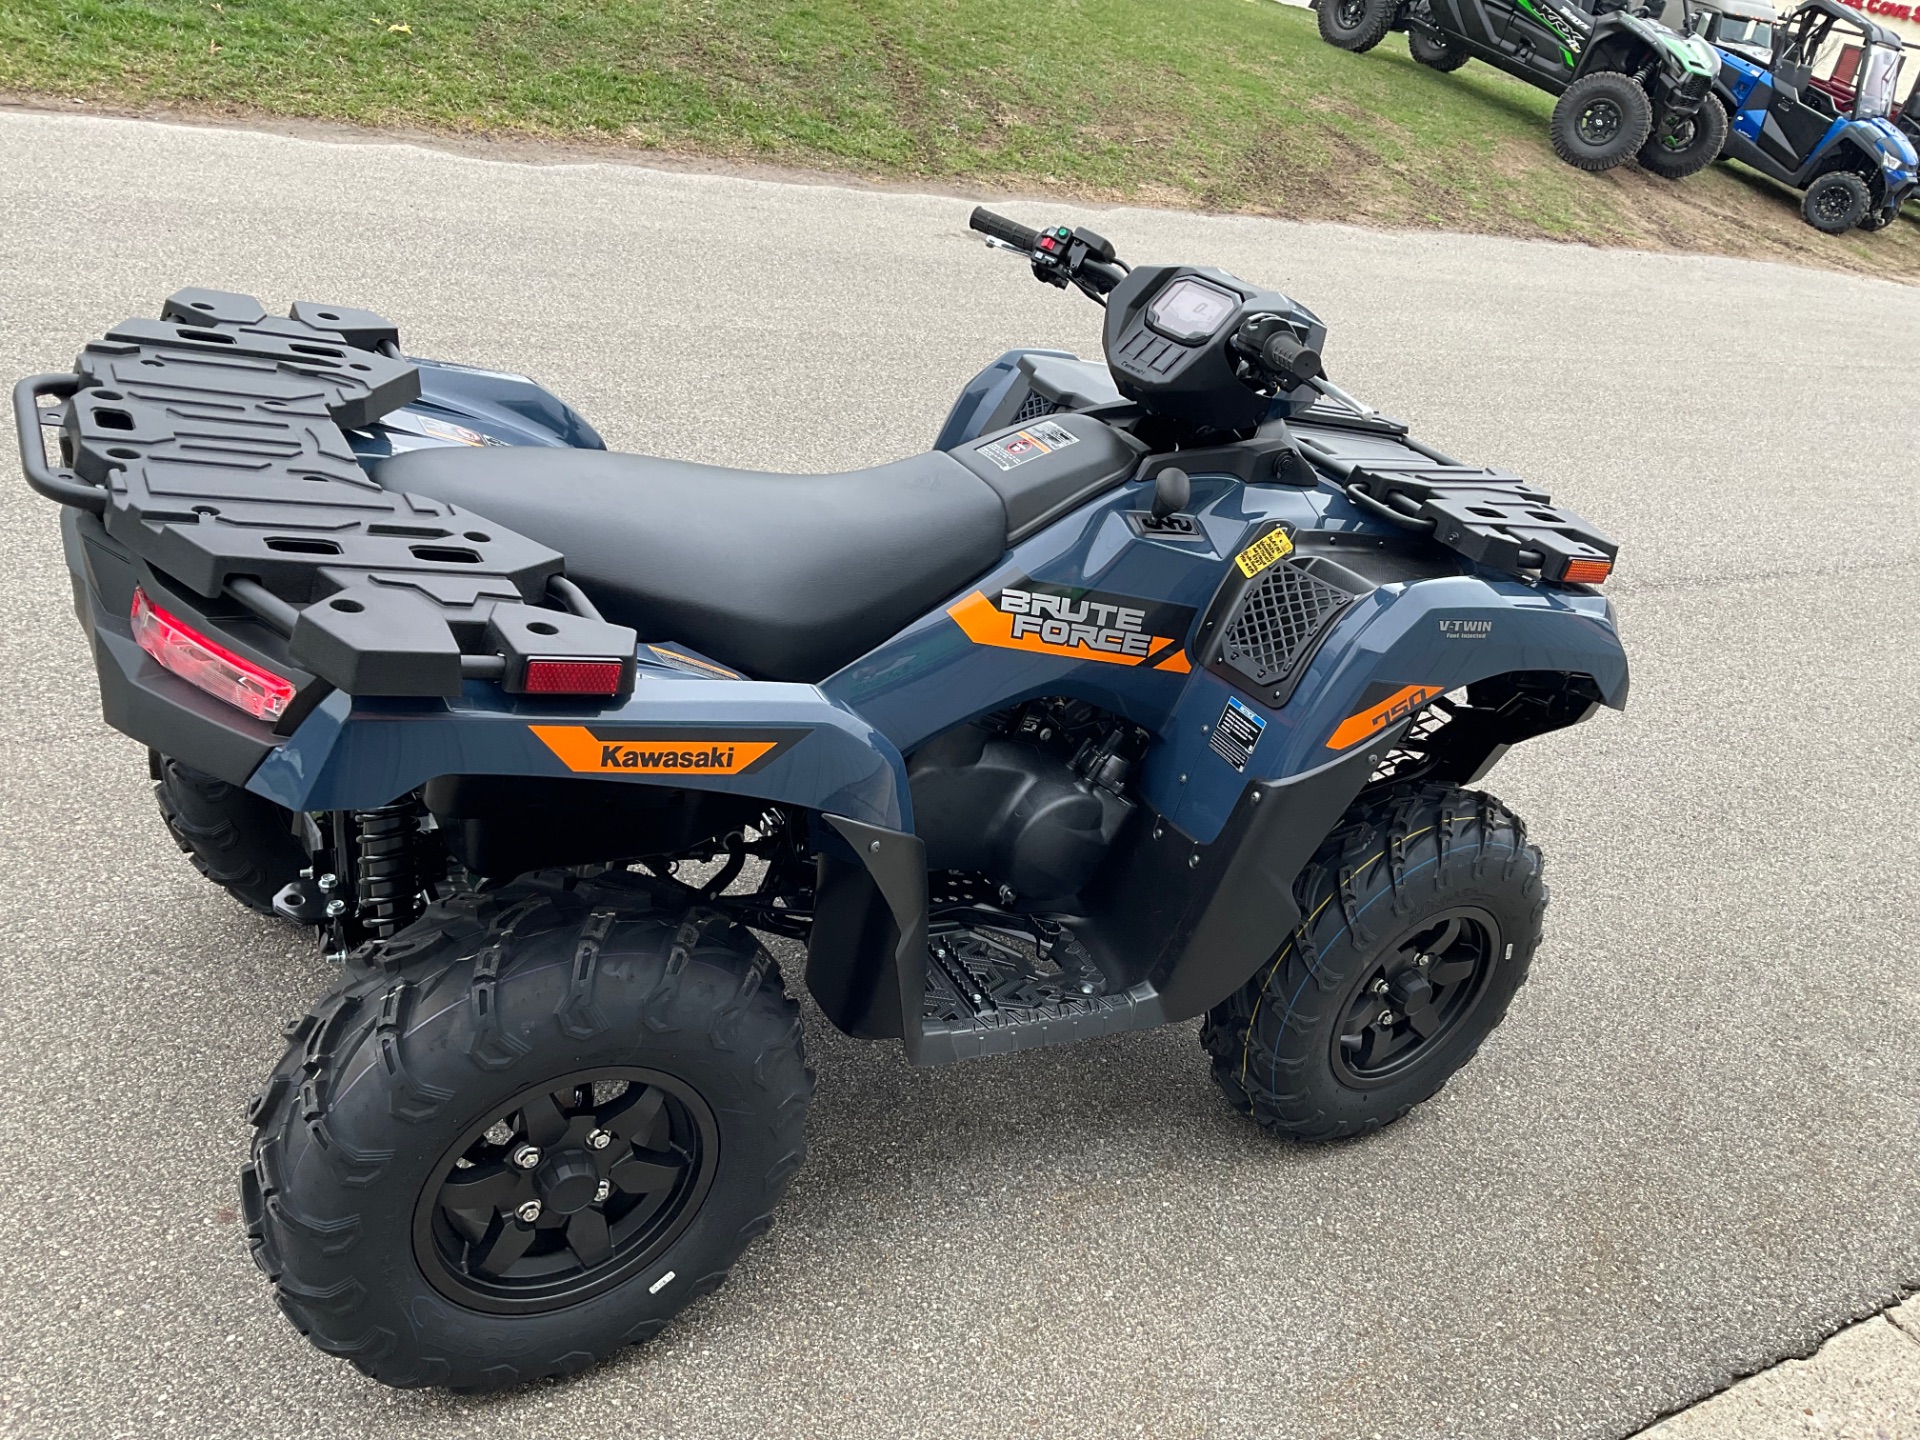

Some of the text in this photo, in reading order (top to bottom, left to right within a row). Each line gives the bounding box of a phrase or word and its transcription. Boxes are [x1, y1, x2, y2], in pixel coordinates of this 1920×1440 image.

[1001, 588, 1145, 632] BRUTE
[1439, 620, 1492, 632] V-TWIN
[1012, 614, 1151, 656] FORCE
[1371, 688, 1427, 727] 750
[600, 745, 734, 768] Kawasaki
